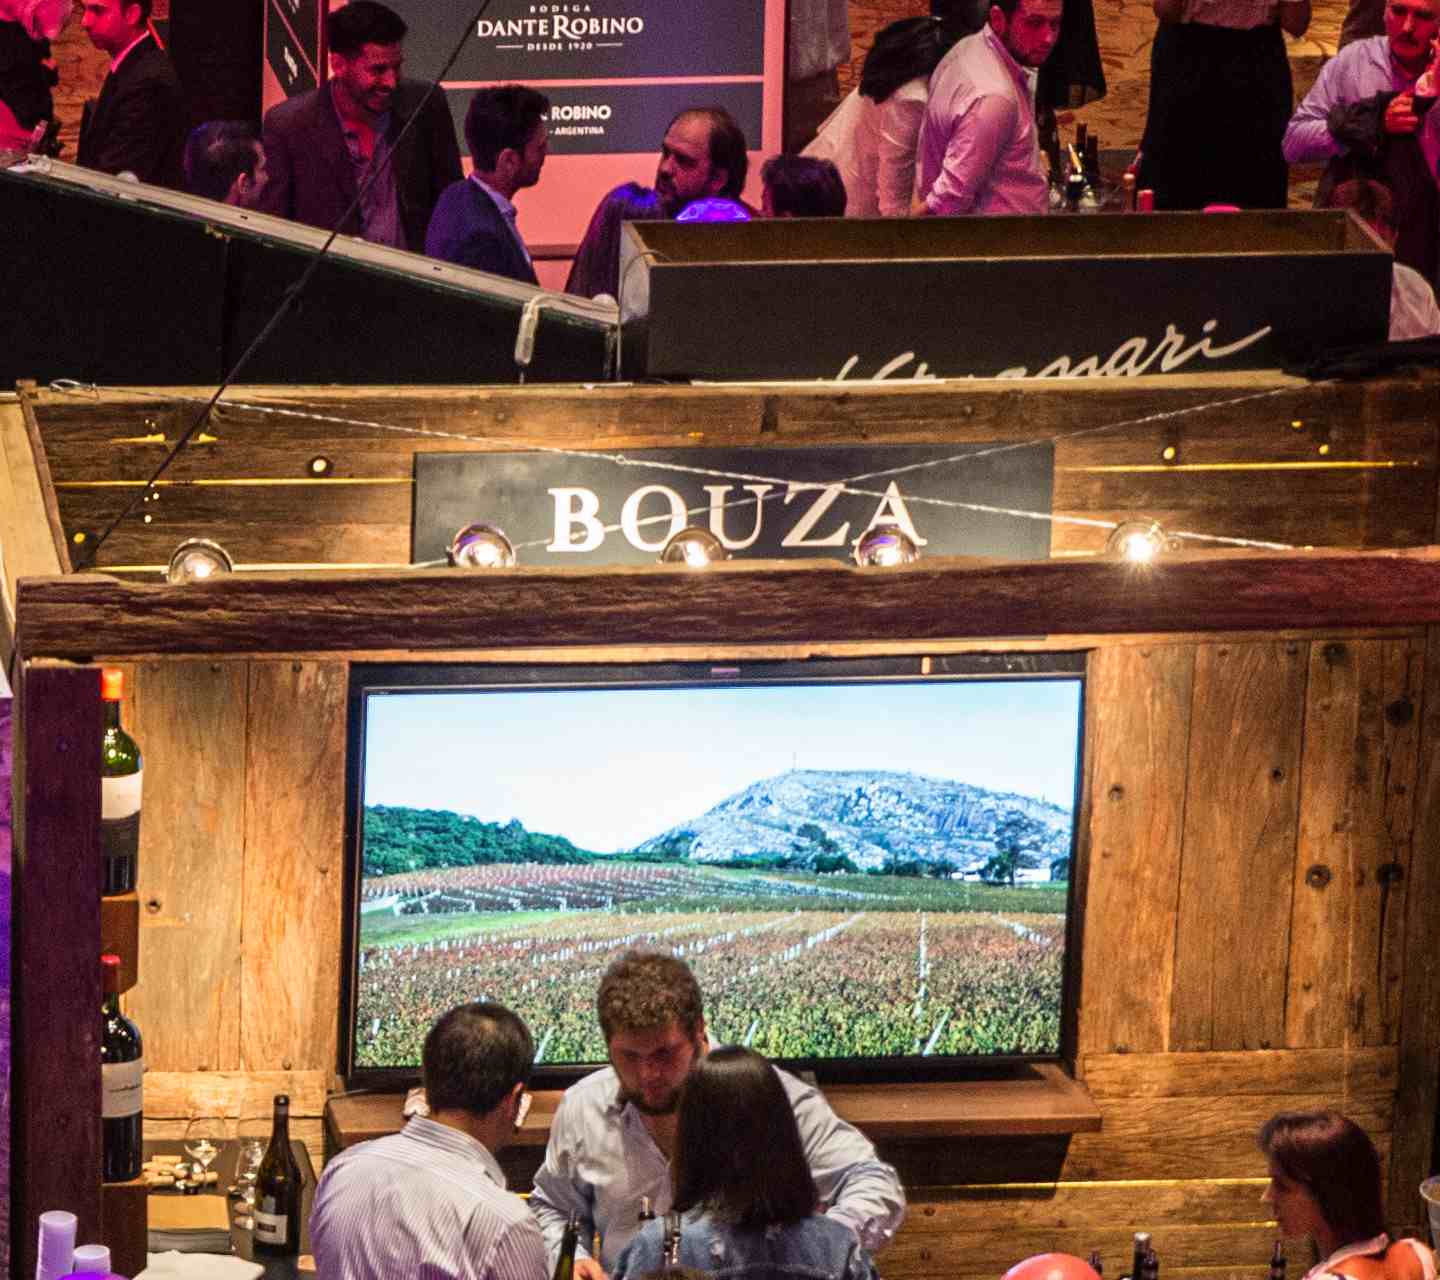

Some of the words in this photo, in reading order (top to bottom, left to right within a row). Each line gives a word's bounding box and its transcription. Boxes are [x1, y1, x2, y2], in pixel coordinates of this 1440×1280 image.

[529, 4, 592, 14] BODEGA
[476, 17, 549, 38] DANTE
[552, 13, 645, 40] ROBINO
[527, 42, 563, 51] DESDE
[550, 104, 612, 121] ROBINO
[554, 125, 605, 136] ARGENTINA
[546, 478, 929, 555] BOUZA
